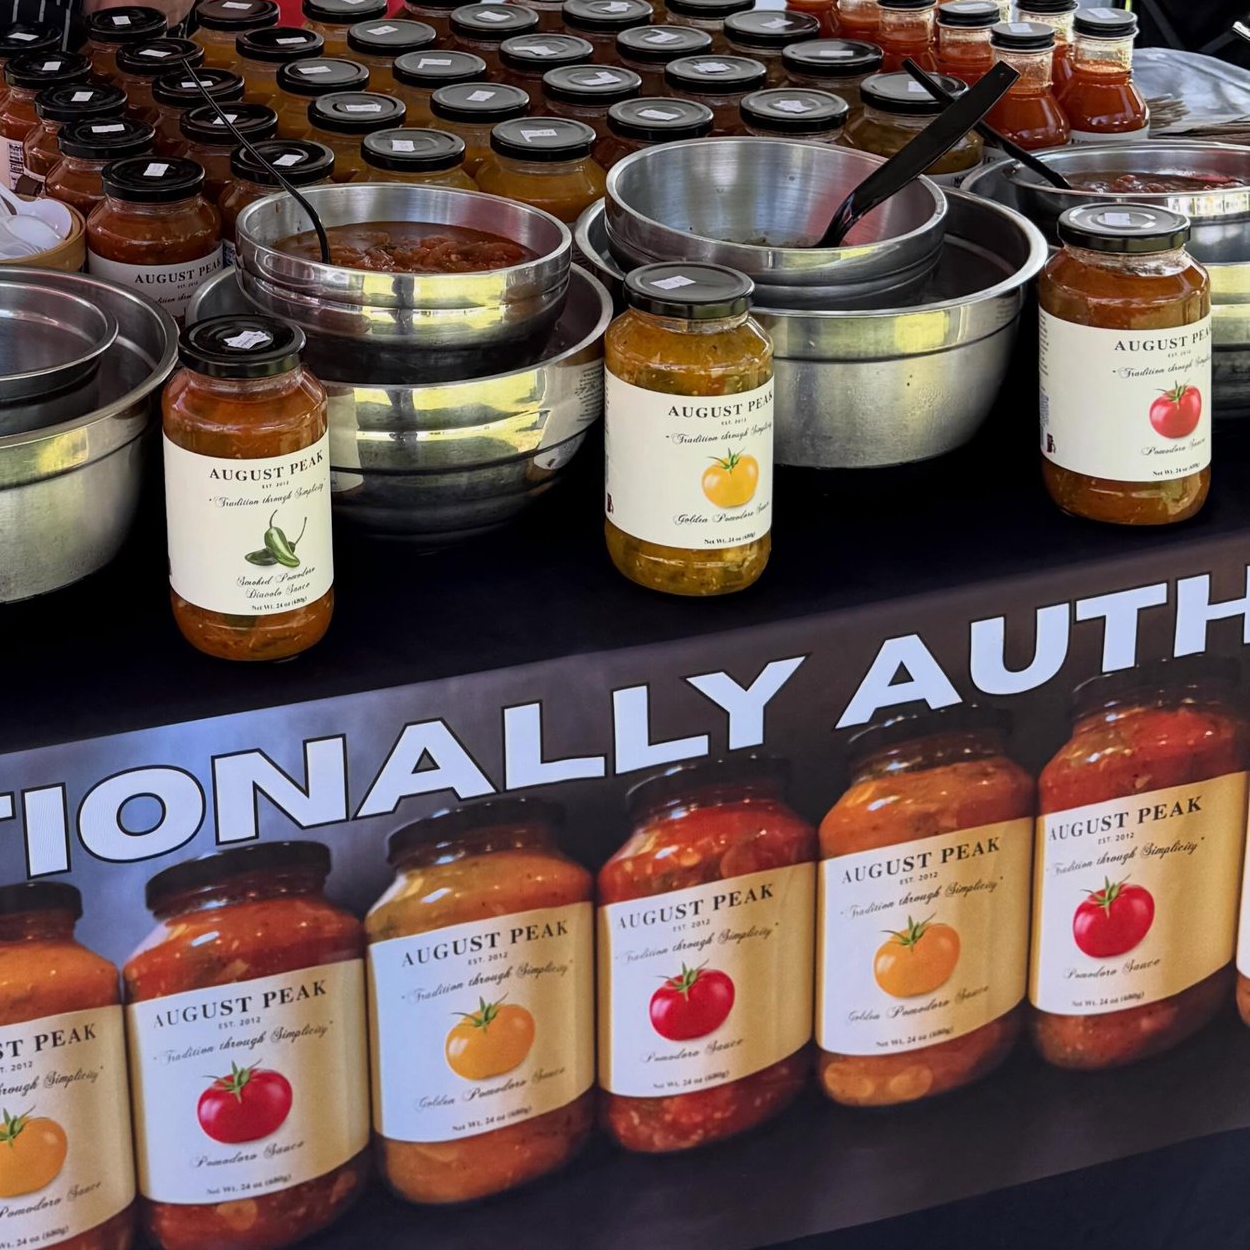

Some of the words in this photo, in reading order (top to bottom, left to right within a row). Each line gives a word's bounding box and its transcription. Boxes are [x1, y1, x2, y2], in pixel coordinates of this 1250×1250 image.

[135, 269, 195, 284] AUGUST
[1114, 335, 1188, 352] AUGUST
[668, 404, 743, 418] AUGUST
[210, 467, 284, 482] AUGUST
[290, 449, 324, 475] PEAK
[833, 564, 1250, 731] AUTH
[1048, 811, 1130, 842] AUGUST
[1137, 796, 1203, 823] PEAK
[841, 851, 933, 885] AUGUST
[941, 836, 1001, 864] PEAK
[617, 898, 705, 930] AUGUST
[713, 883, 775, 915] PEAK
[401, 932, 501, 968] AUGUST
[510, 919, 569, 944] PEAK
[153, 996, 253, 1029] AUGUST
[262, 979, 328, 1009] PEAK
[35, 1022, 98, 1053] PEAK
[68, 1181, 103, 1202] Sauce
